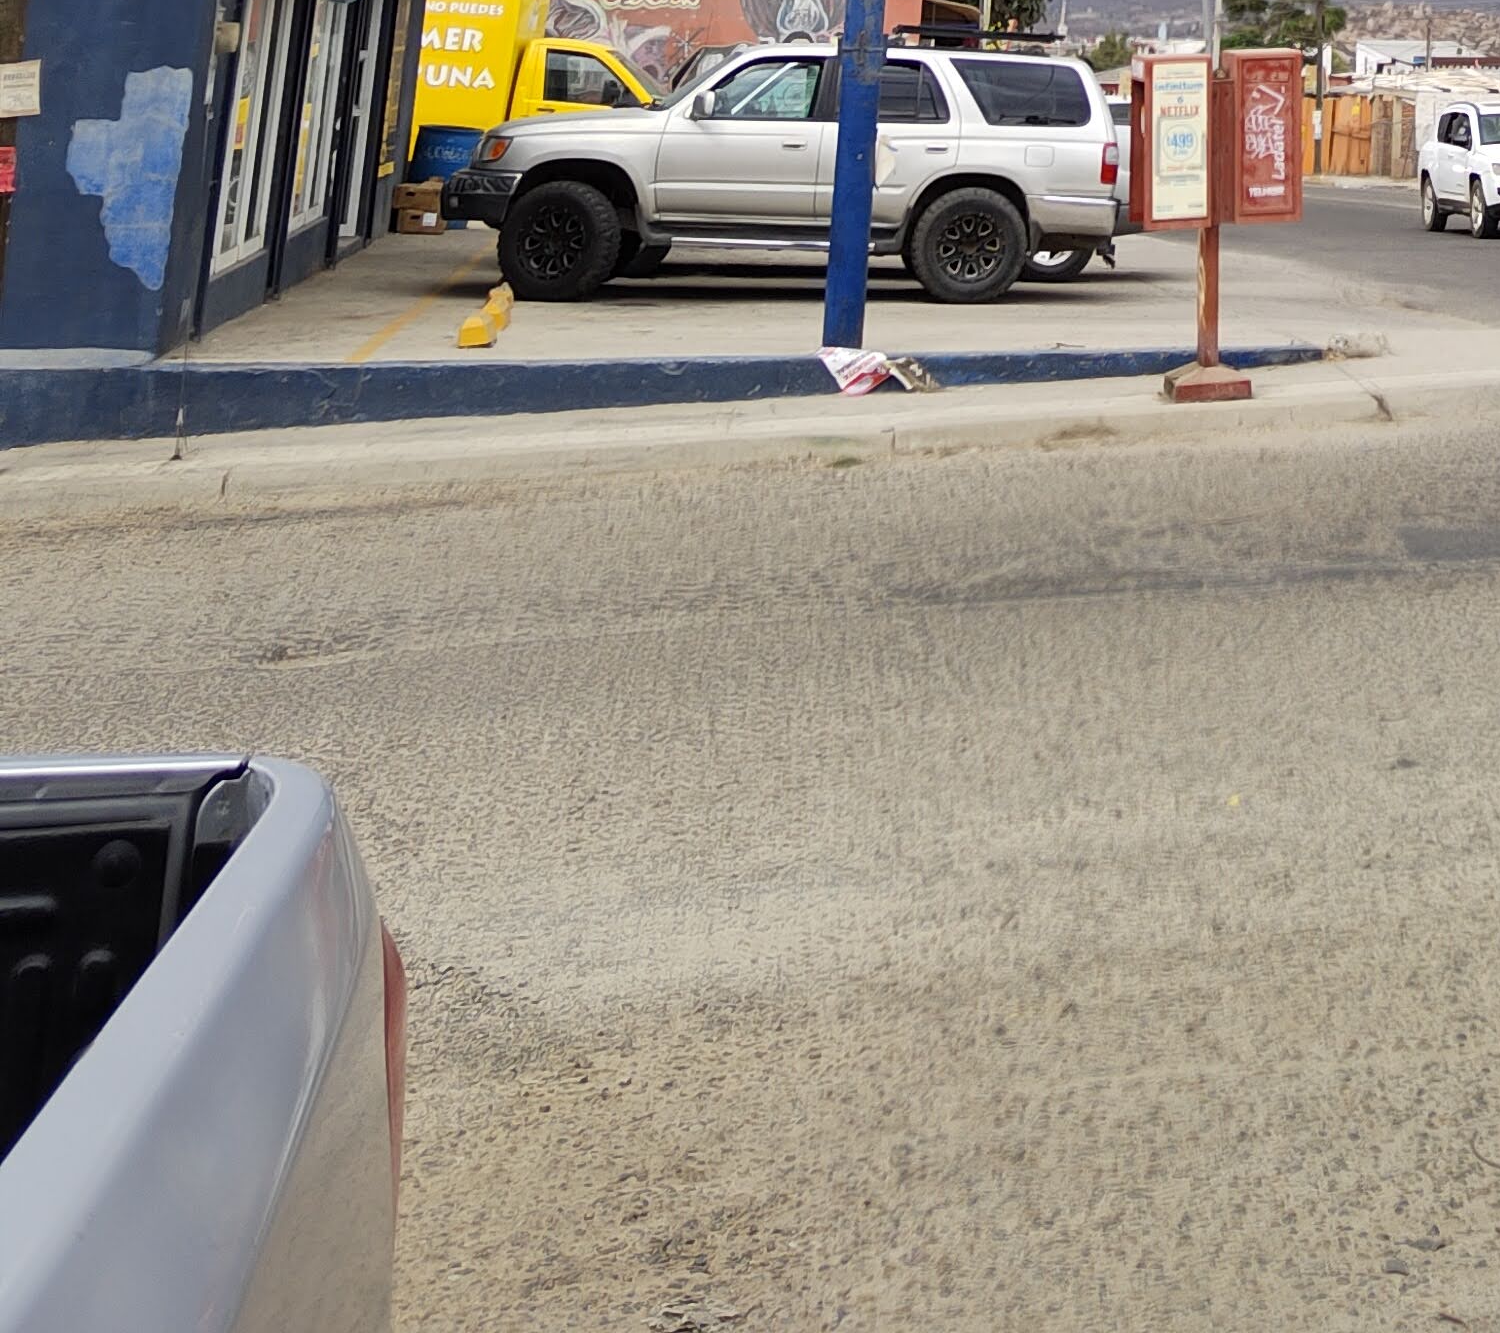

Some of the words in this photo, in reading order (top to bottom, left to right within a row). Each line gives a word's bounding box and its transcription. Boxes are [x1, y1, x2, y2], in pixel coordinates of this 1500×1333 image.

[449, 2, 505, 17] PUEDES
[1160, 105, 1200, 117] NETFLIX
[1271, 118, 1285, 181] Ladatel
